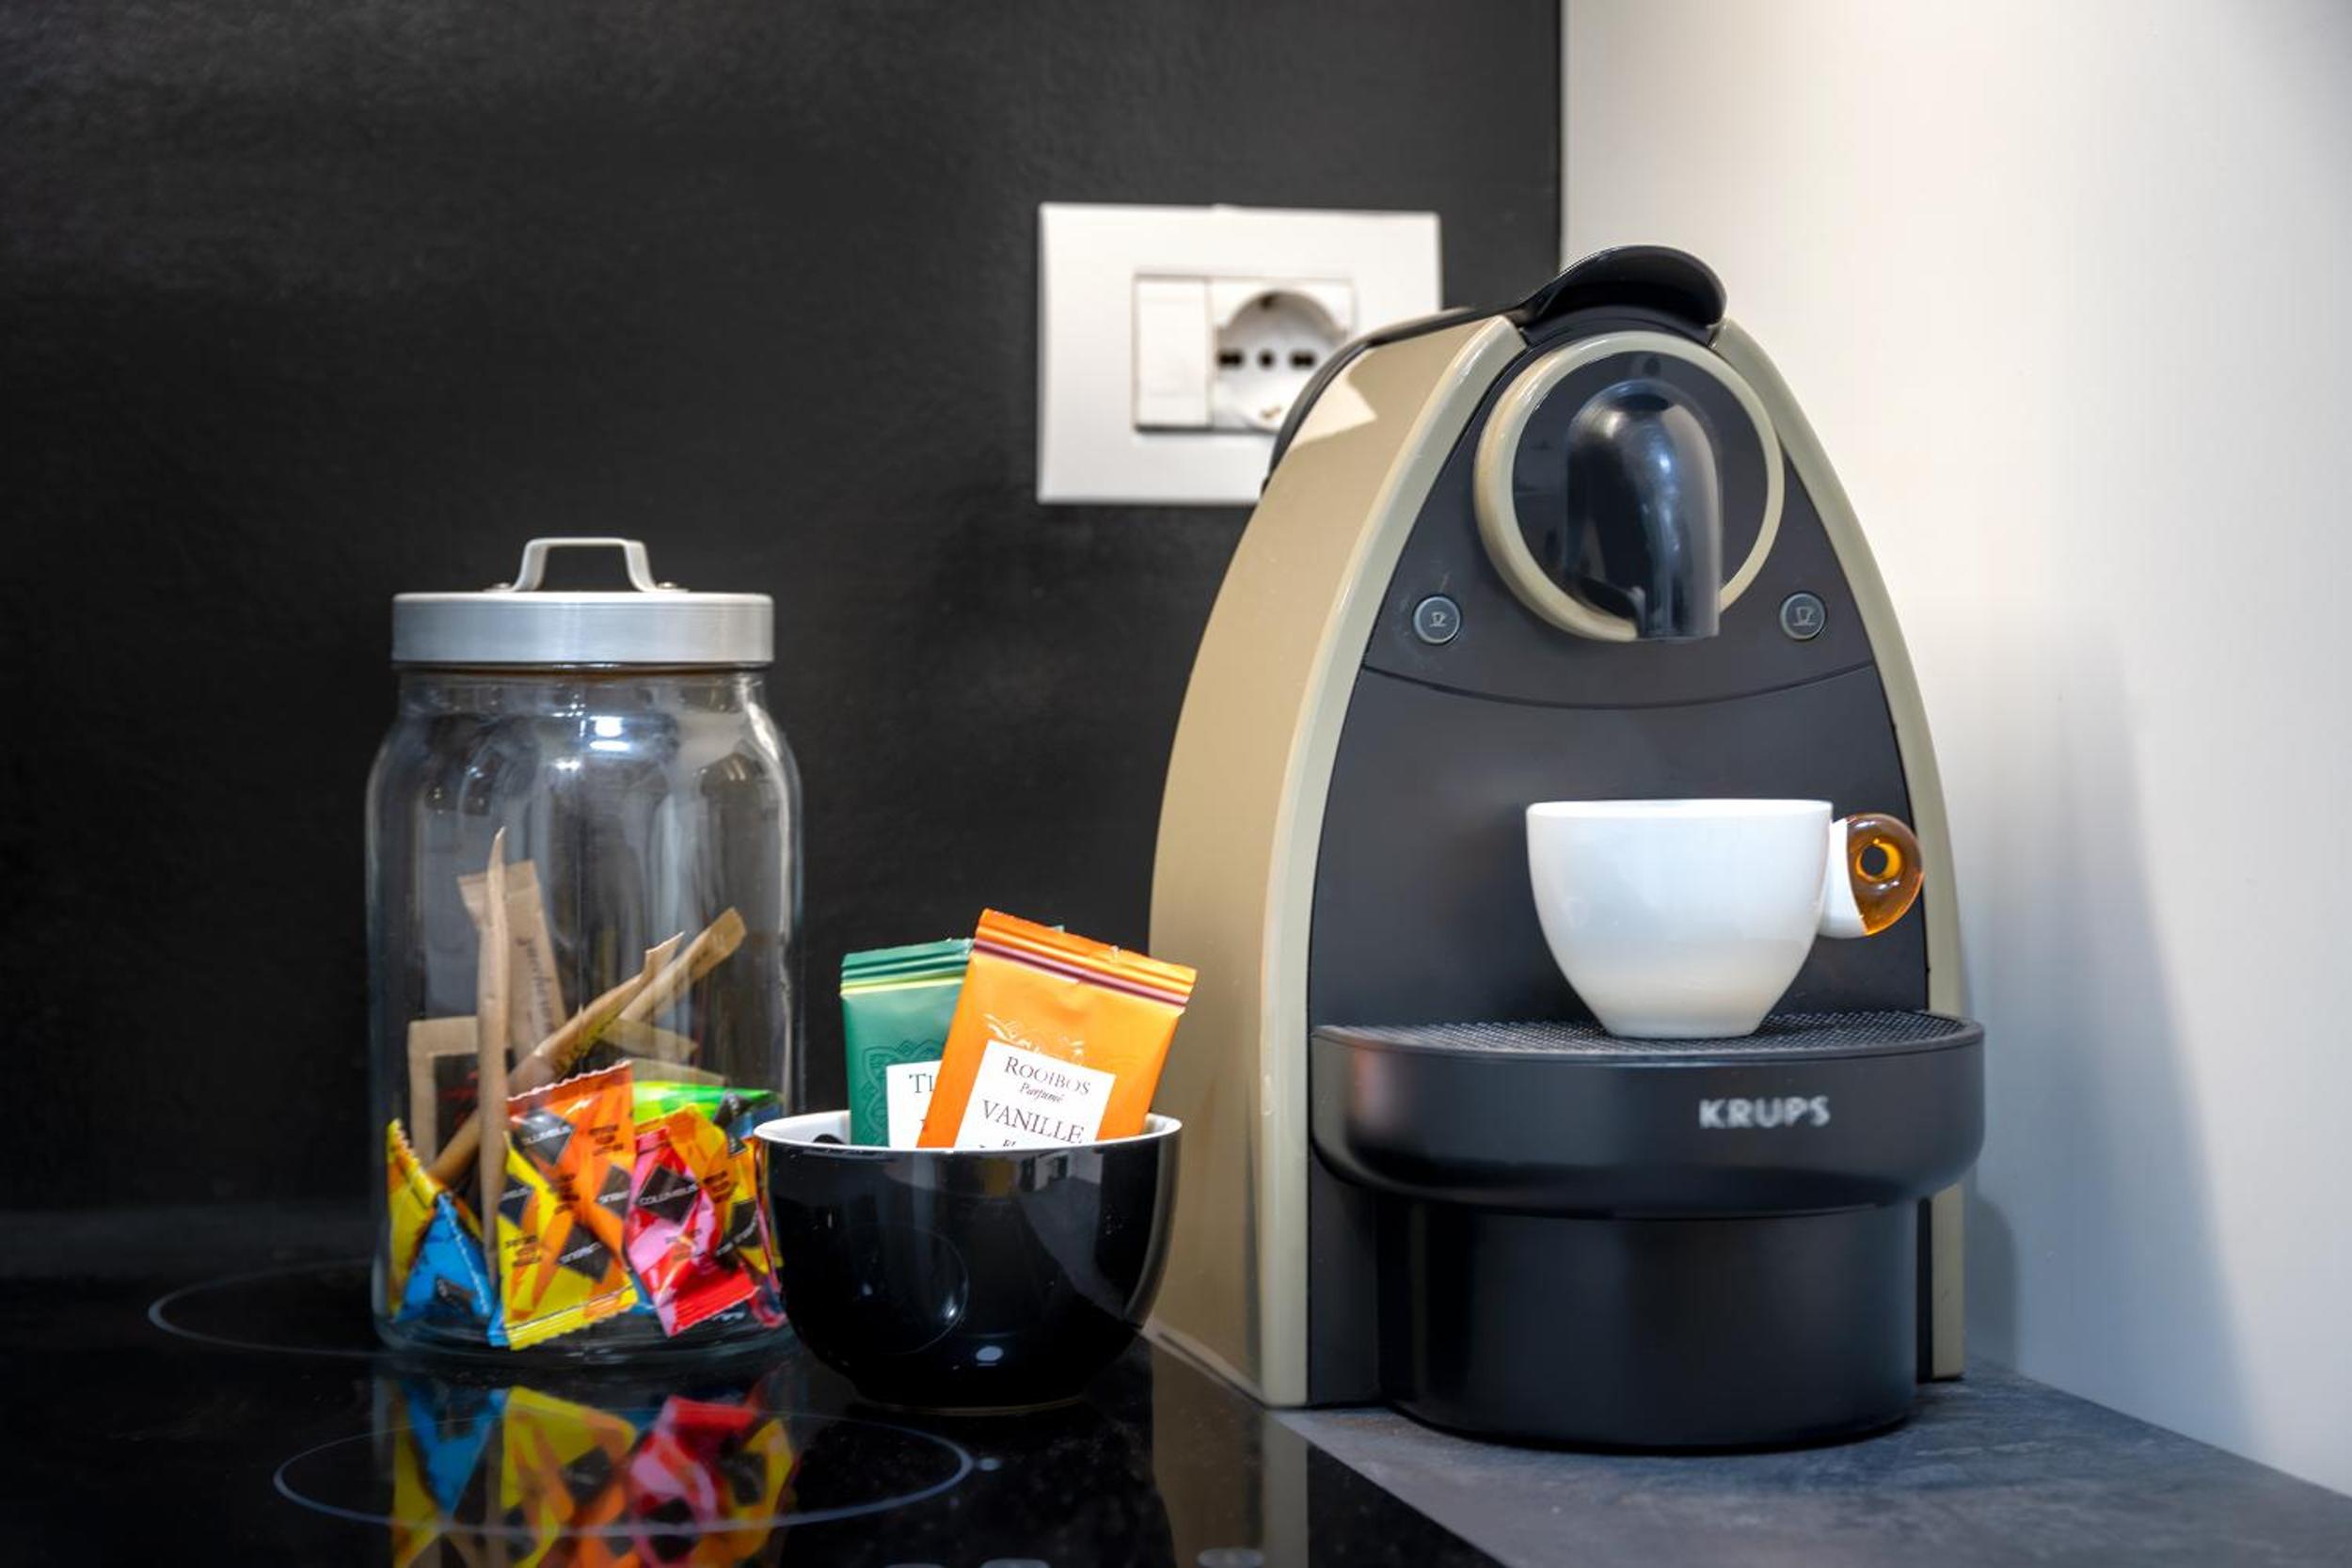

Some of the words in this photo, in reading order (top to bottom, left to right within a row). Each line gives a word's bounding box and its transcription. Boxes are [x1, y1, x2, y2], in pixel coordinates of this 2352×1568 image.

[1003, 1055, 1091, 1095] ROOIBOS
[981, 1099, 1085, 1144] VANILLE
[1698, 1095, 1831, 1129] KRUPS
